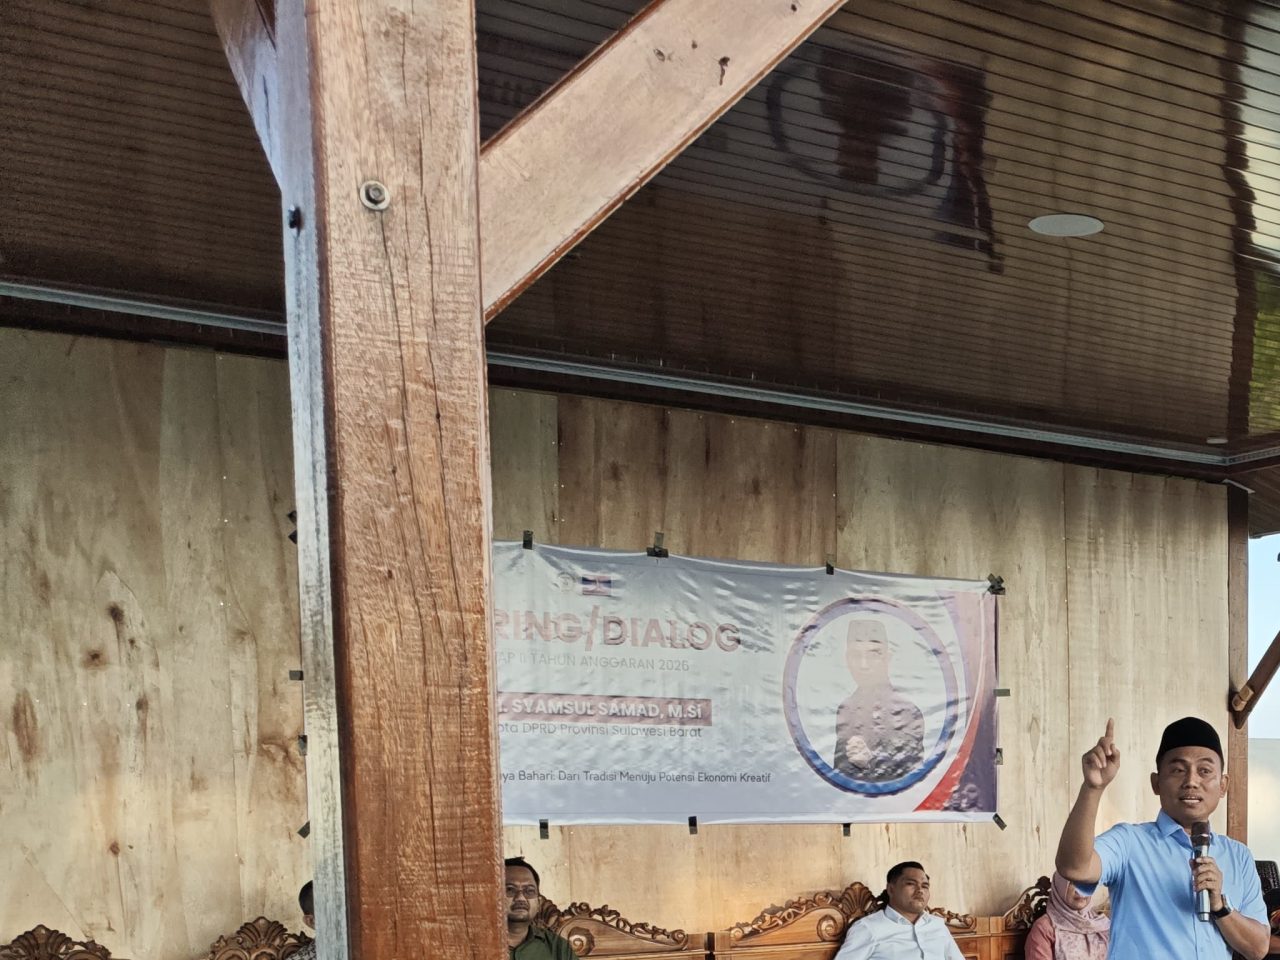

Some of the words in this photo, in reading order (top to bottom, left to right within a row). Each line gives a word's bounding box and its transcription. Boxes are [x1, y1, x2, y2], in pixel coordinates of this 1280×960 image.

[530, 652, 577, 667] TAHUN
[580, 655, 655, 670] ANGGARAN
[511, 698, 595, 716] SYAMSUL
[599, 700, 665, 719] SAMAD,
[668, 703, 703, 719] M.Si
[522, 722, 557, 735] DPRD
[560, 723, 609, 736] Provinsi
[611, 724, 666, 738] Sulawesi
[669, 726, 703, 738] Barat
[558, 770, 580, 781] Dari
[583, 770, 617, 782] Tradisi
[620, 770, 657, 785] Menuju
[659, 771, 695, 782] Potensi
[698, 771, 738, 783] Ekonomi
[740, 772, 772, 783] Kreatif
